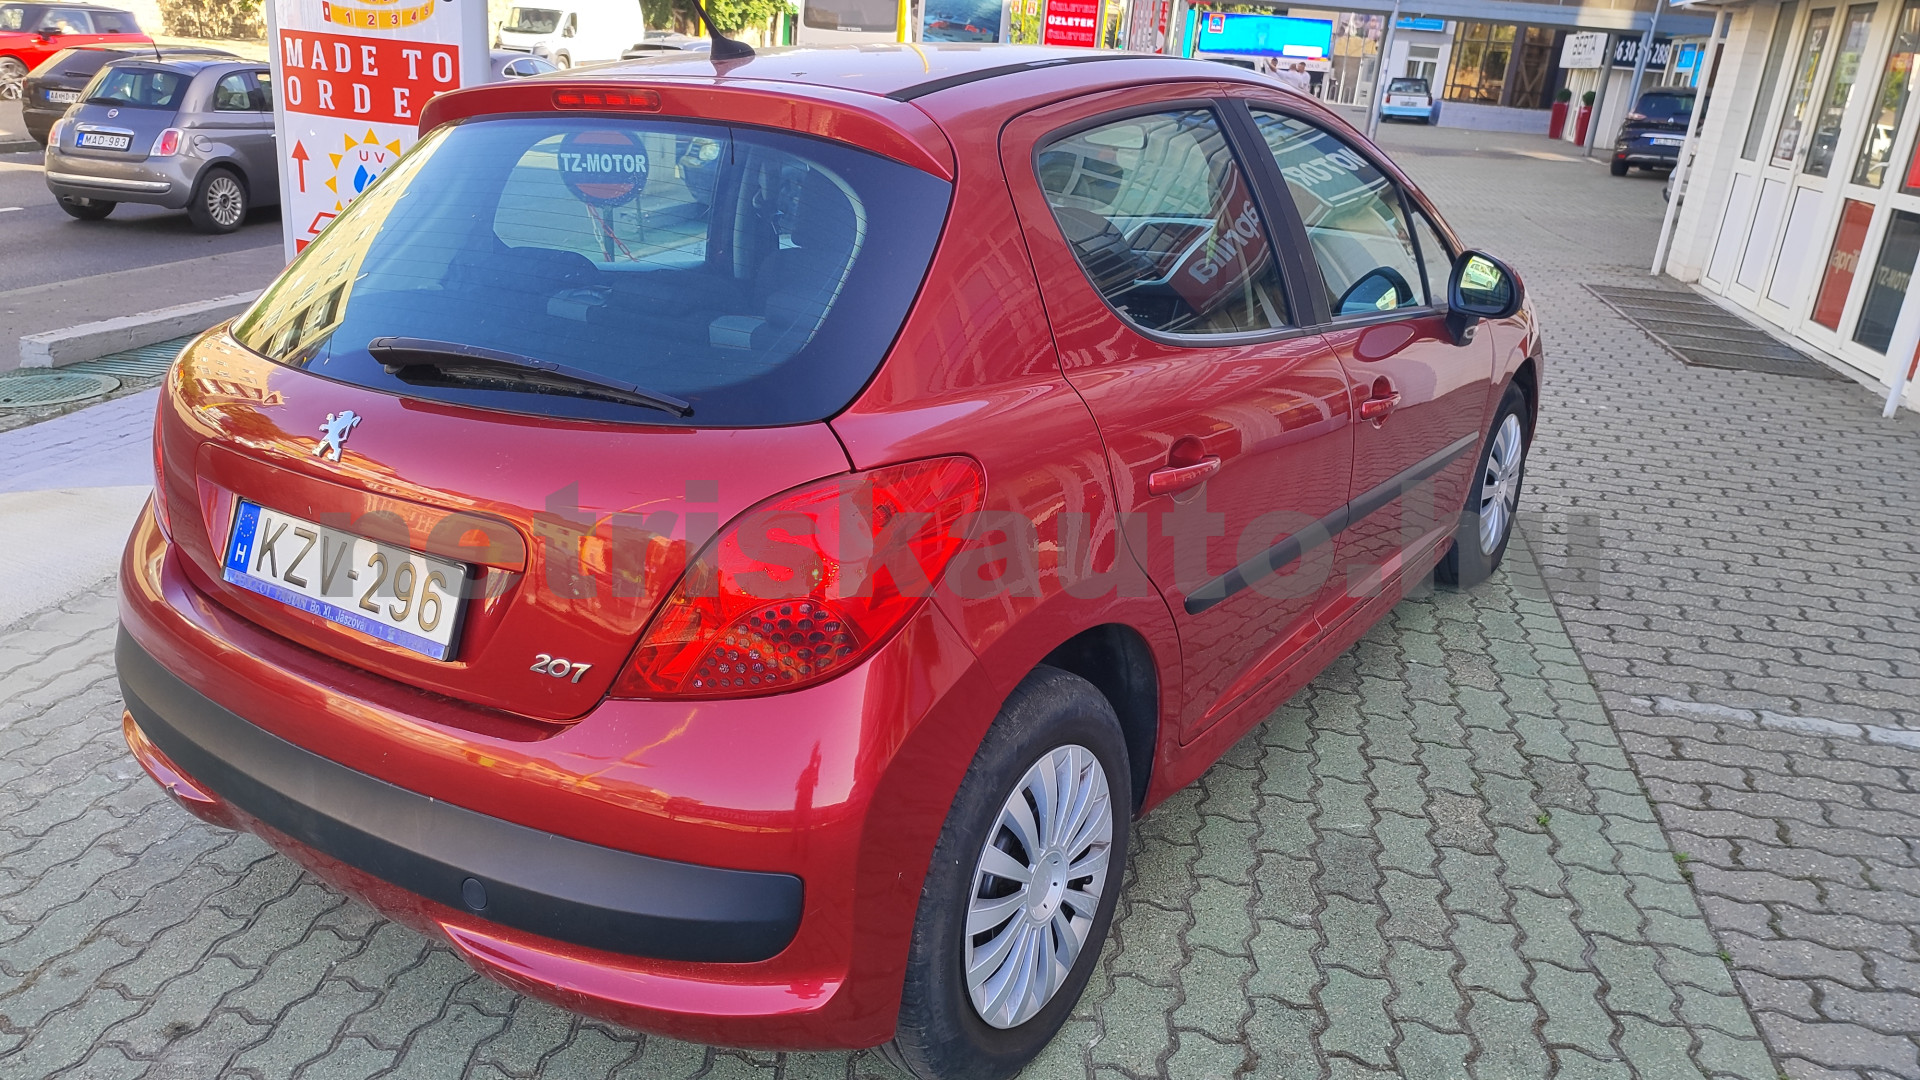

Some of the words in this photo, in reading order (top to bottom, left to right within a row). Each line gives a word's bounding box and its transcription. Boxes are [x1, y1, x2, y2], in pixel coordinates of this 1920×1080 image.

[346, 13, 351, 23] 1
[367, 15, 375, 25] 2
[391, 14, 398, 25] 3
[411, 11, 417, 22] 4
[424, 7, 429, 16] 5
[285, 37, 378, 77] MADE
[402, 49, 453, 83] TO
[287, 75, 444, 118] ORDE
[84, 135, 127, 148] MAD-983
[560, 153, 647, 173] TZ-MOTOR
[234, 543, 248, 564] H
[255, 517, 447, 632] KZV-296
[529, 653, 592, 684] 207
